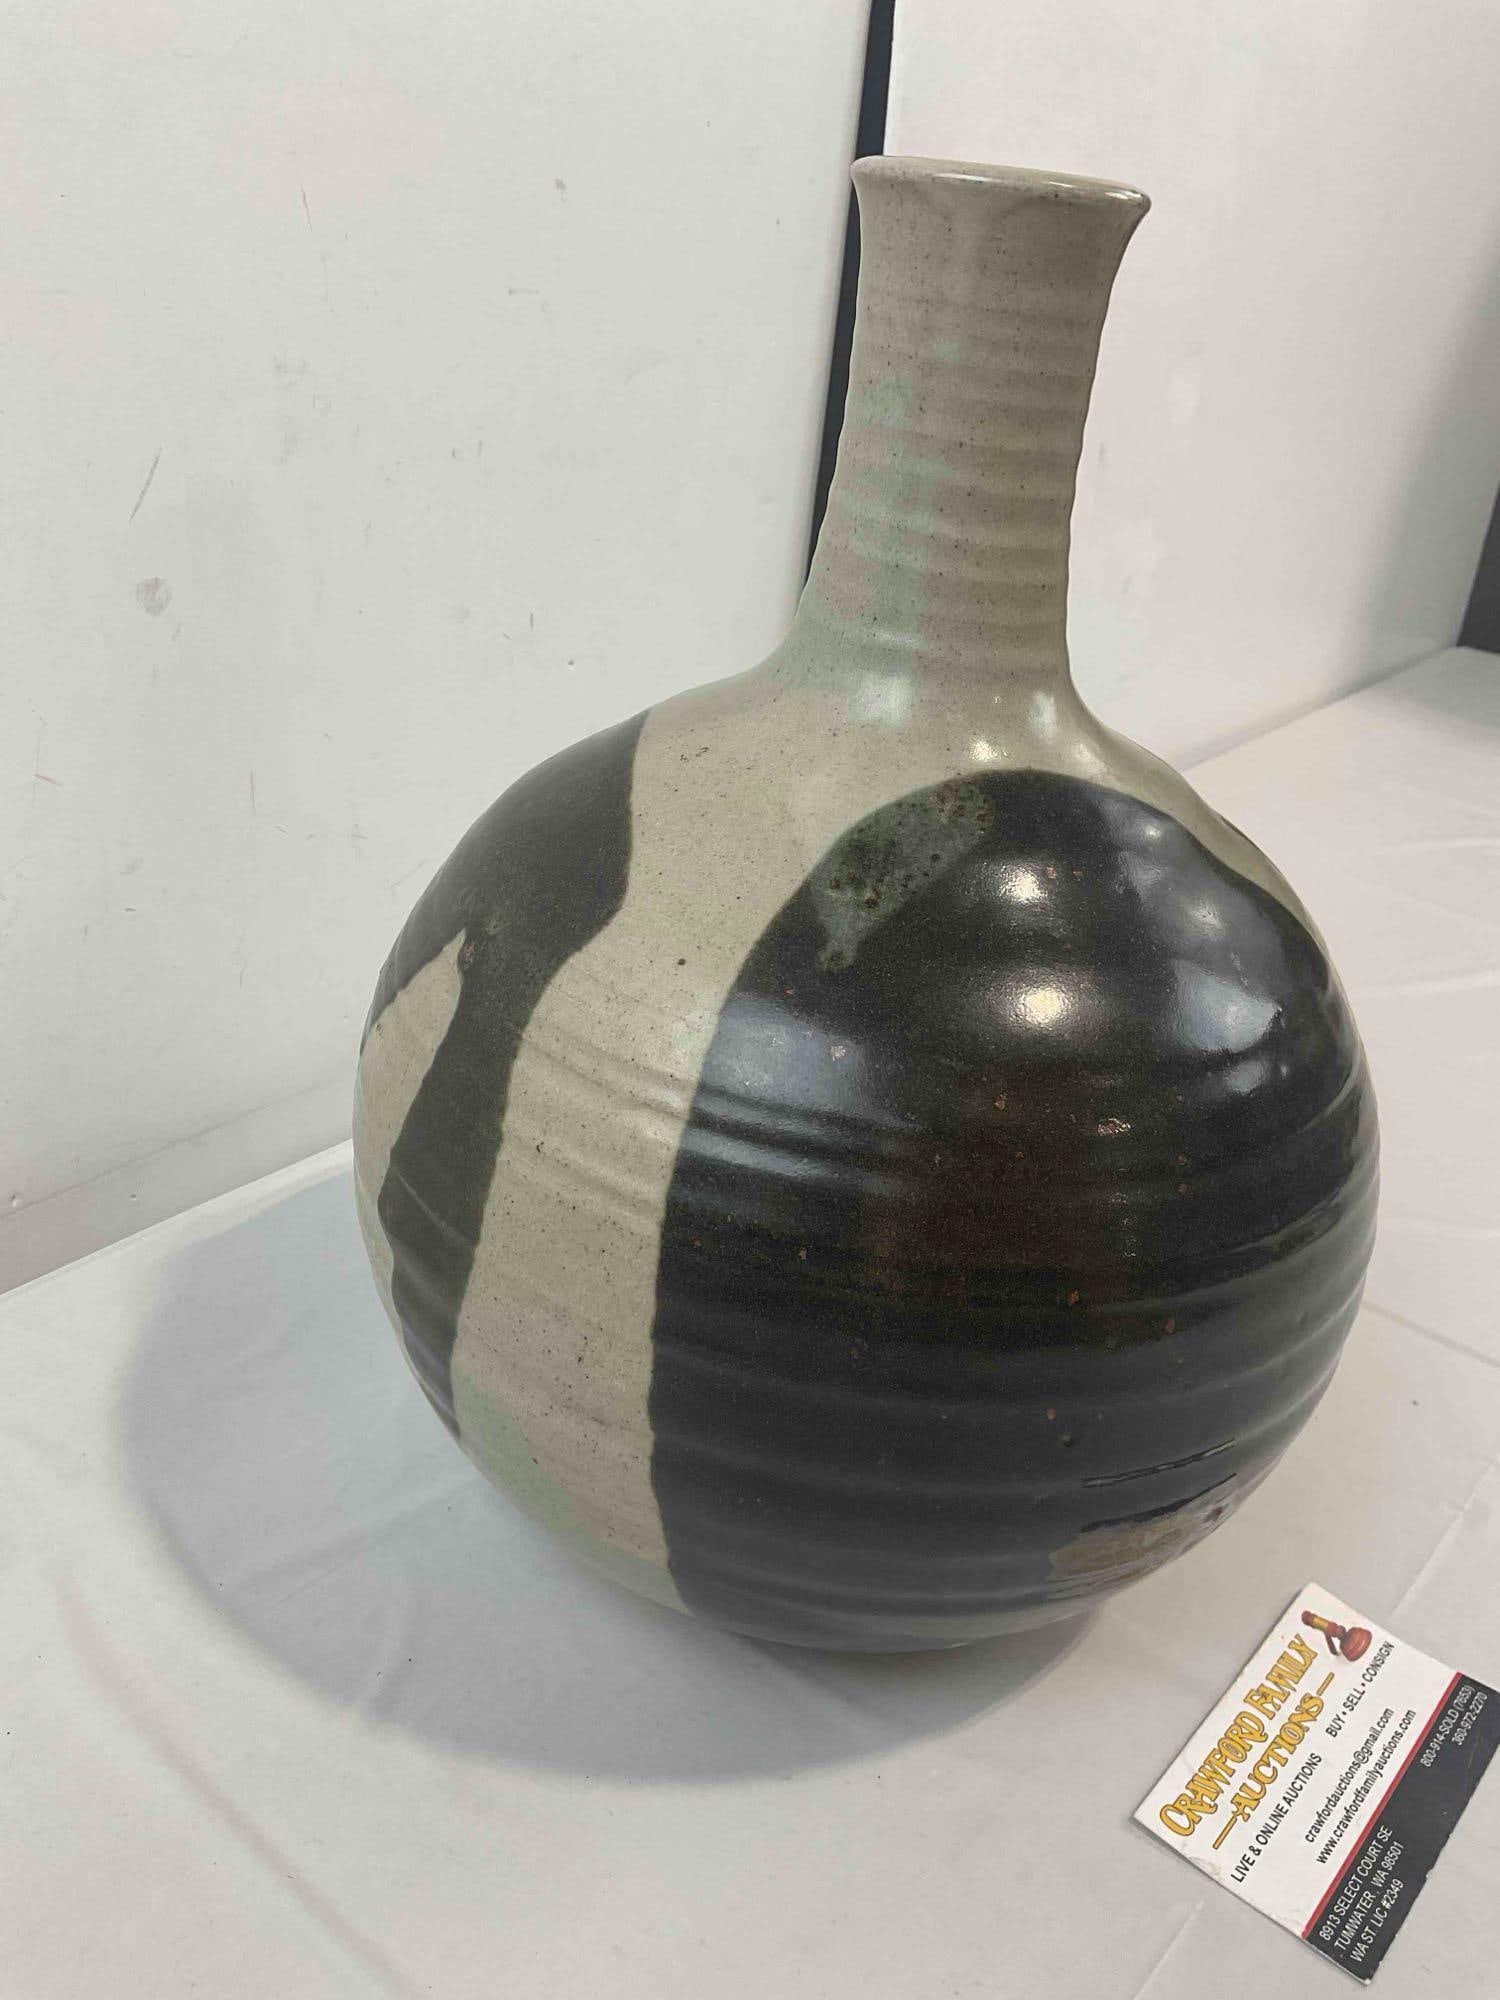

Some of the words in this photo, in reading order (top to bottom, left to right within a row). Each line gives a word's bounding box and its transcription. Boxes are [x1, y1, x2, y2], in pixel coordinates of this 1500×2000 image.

[1325, 1714, 1345, 1738] BUY
[1343, 1689, 1365, 1713] SELL
[1362, 1640, 1395, 1682] CONSIGN
[1420, 1708, 1459, 1767] 800-914-SOLD
[1453, 1685, 1475, 1711] (7653)
[1451, 1691, 1488, 1746] 360-972-2270
[1160, 1711, 1268, 1836] CRAWFORD
[1243, 1633, 1318, 1720] FAMILY
[1232, 1692, 1324, 1822] AUCTIONS
[1305, 1708, 1394, 1843] crawfordauctions@gmail.com
[1256, 1803, 1289, 1845] ONLINE
[1282, 1752, 1322, 1815] AUCTIONS
[1316, 1709, 1416, 1864] www.crawfordfamilyauctions.com
[1230, 1853, 1256, 1883] LIVE
[1254, 1845, 1262, 1857] &
[1319, 1914, 1341, 1941] 8913
[1334, 1874, 1363, 1916] SELECT
[1357, 1840, 1384, 1877] COURT
[1377, 1825, 1393, 1842] SE
[1371, 1870, 1389, 1888] WA
[1381, 1841, 1404, 1871] 98501
[1350, 1942, 1368, 1962] WA
[1370, 1907, 1388, 1928] LIC
[1381, 1878, 1404, 1910] #2349
